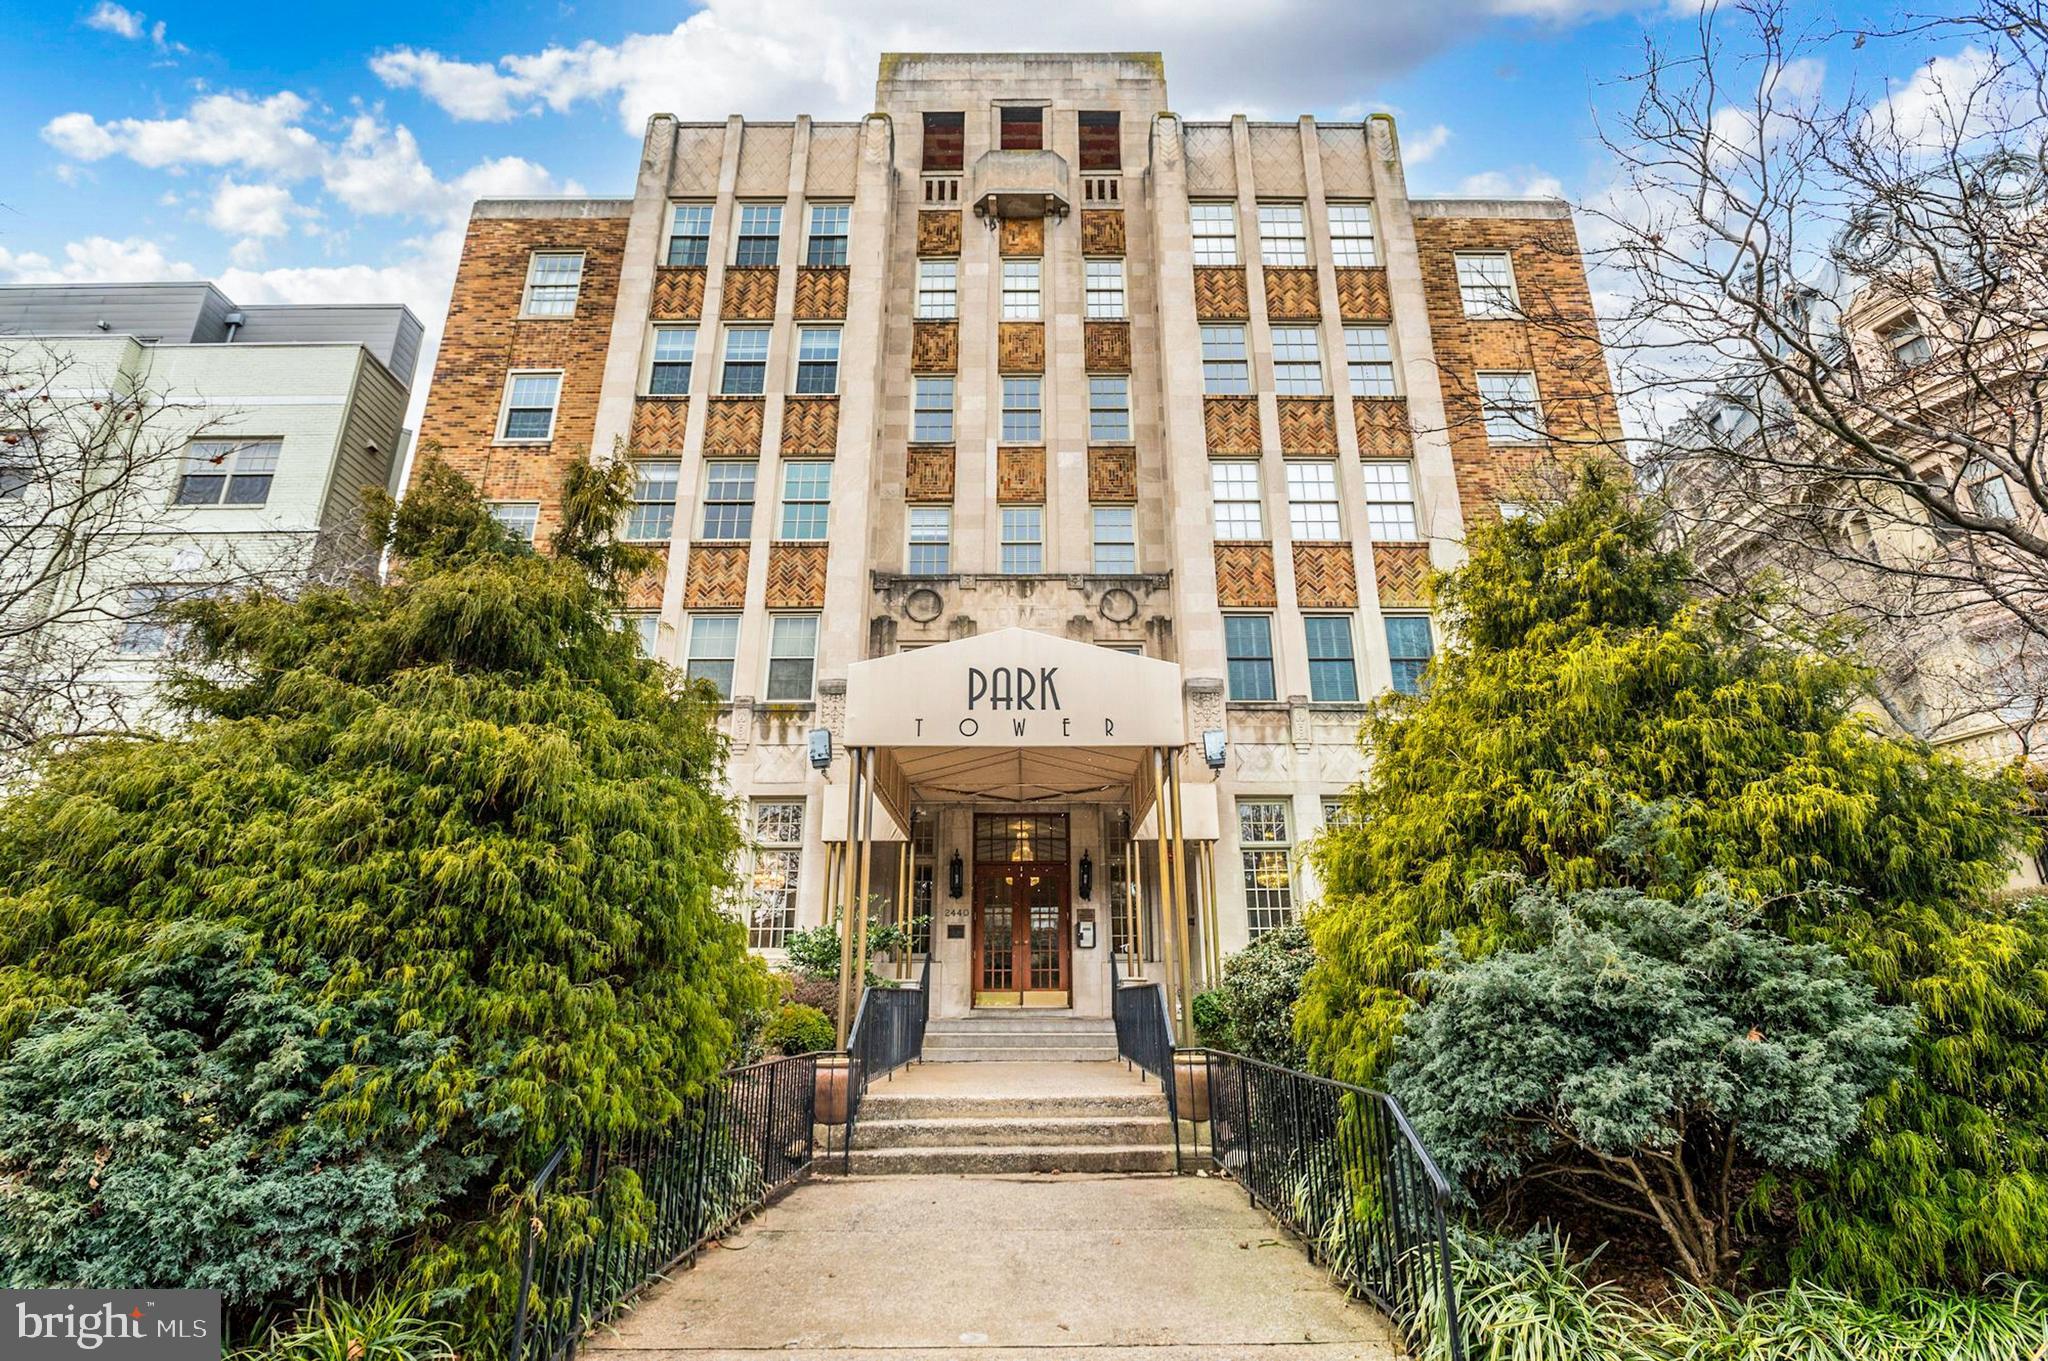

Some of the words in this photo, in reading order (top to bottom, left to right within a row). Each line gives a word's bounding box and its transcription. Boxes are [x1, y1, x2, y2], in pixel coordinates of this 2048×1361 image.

[968, 667, 1061, 711] PARK
[915, 718, 1114, 737] TOWER
[944, 908, 970, 917] 2440
